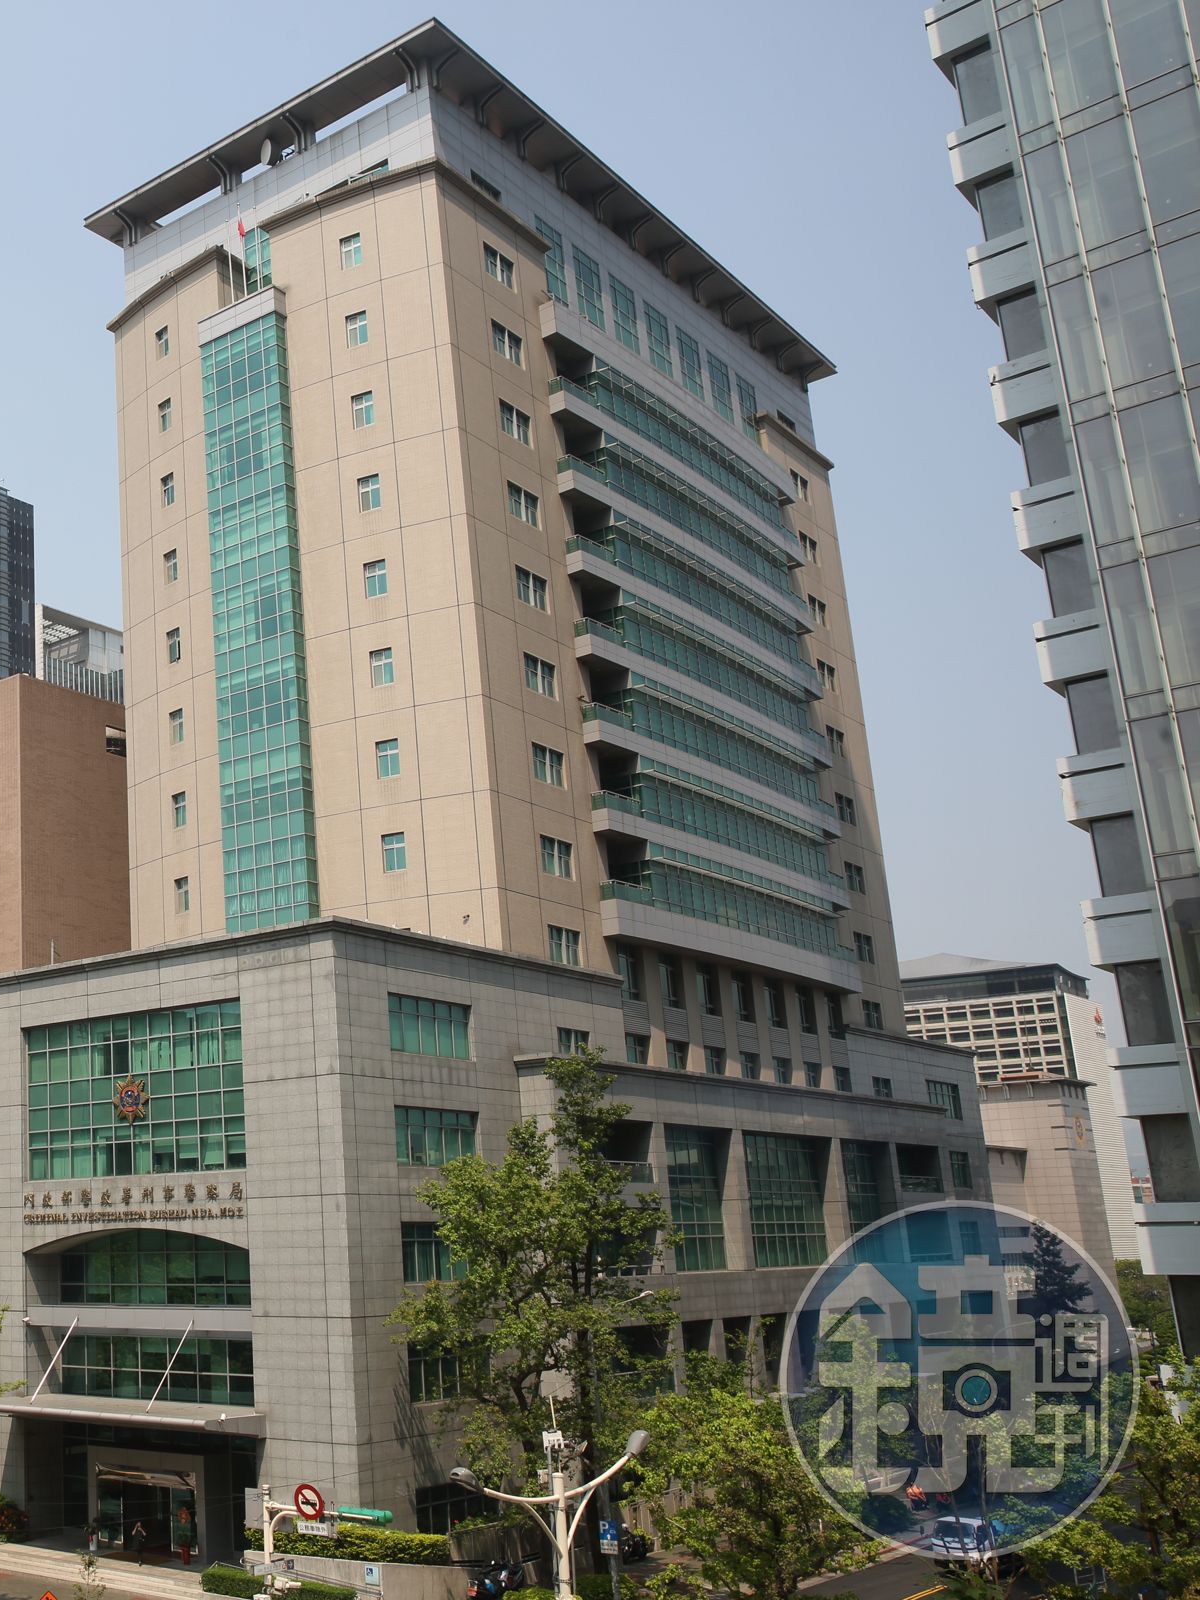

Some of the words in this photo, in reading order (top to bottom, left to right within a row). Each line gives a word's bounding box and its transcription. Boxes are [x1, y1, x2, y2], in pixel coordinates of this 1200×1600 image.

[23, 1212, 69, 1224] CRIMINAL
[71, 1209, 147, 1223] INVESTIGATION
[600, 1521, 608, 1534] P
